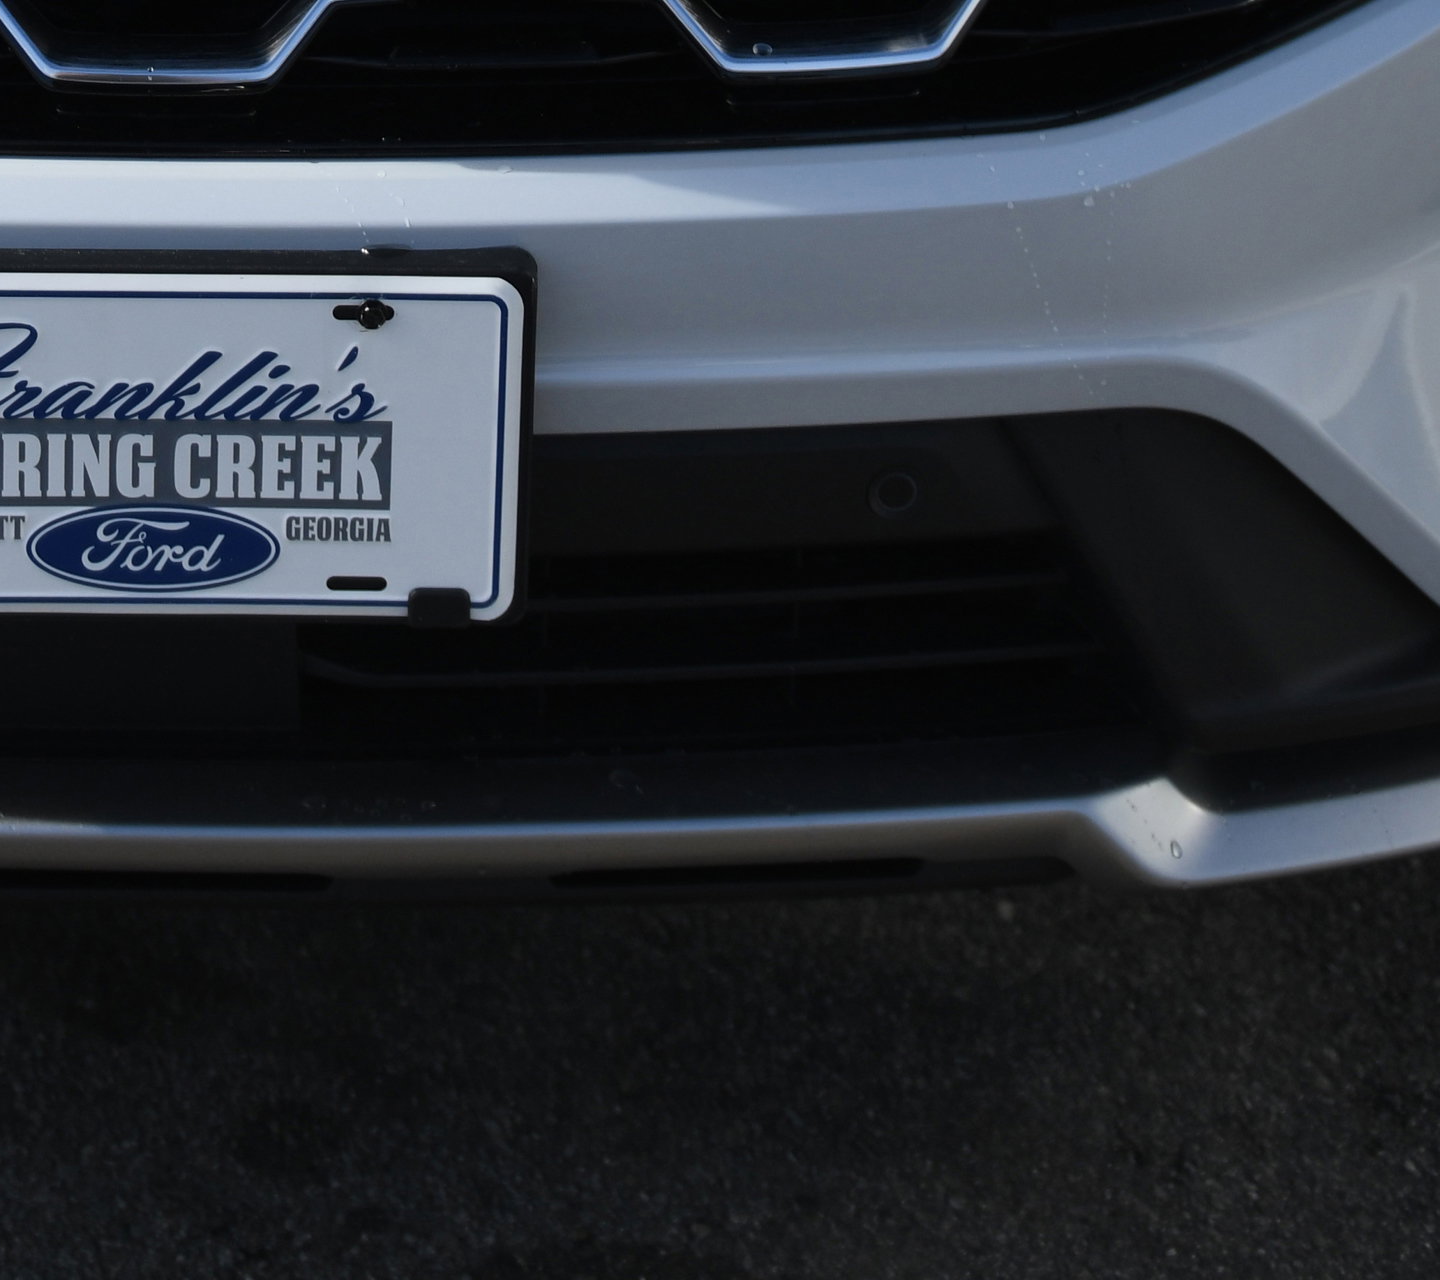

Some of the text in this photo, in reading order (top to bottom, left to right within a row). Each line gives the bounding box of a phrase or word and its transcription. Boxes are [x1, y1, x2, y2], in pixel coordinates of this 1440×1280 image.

[173, 433, 383, 501] CREEK
[80, 516, 226, 572] Ford
[285, 515, 392, 543] GEORGIA
